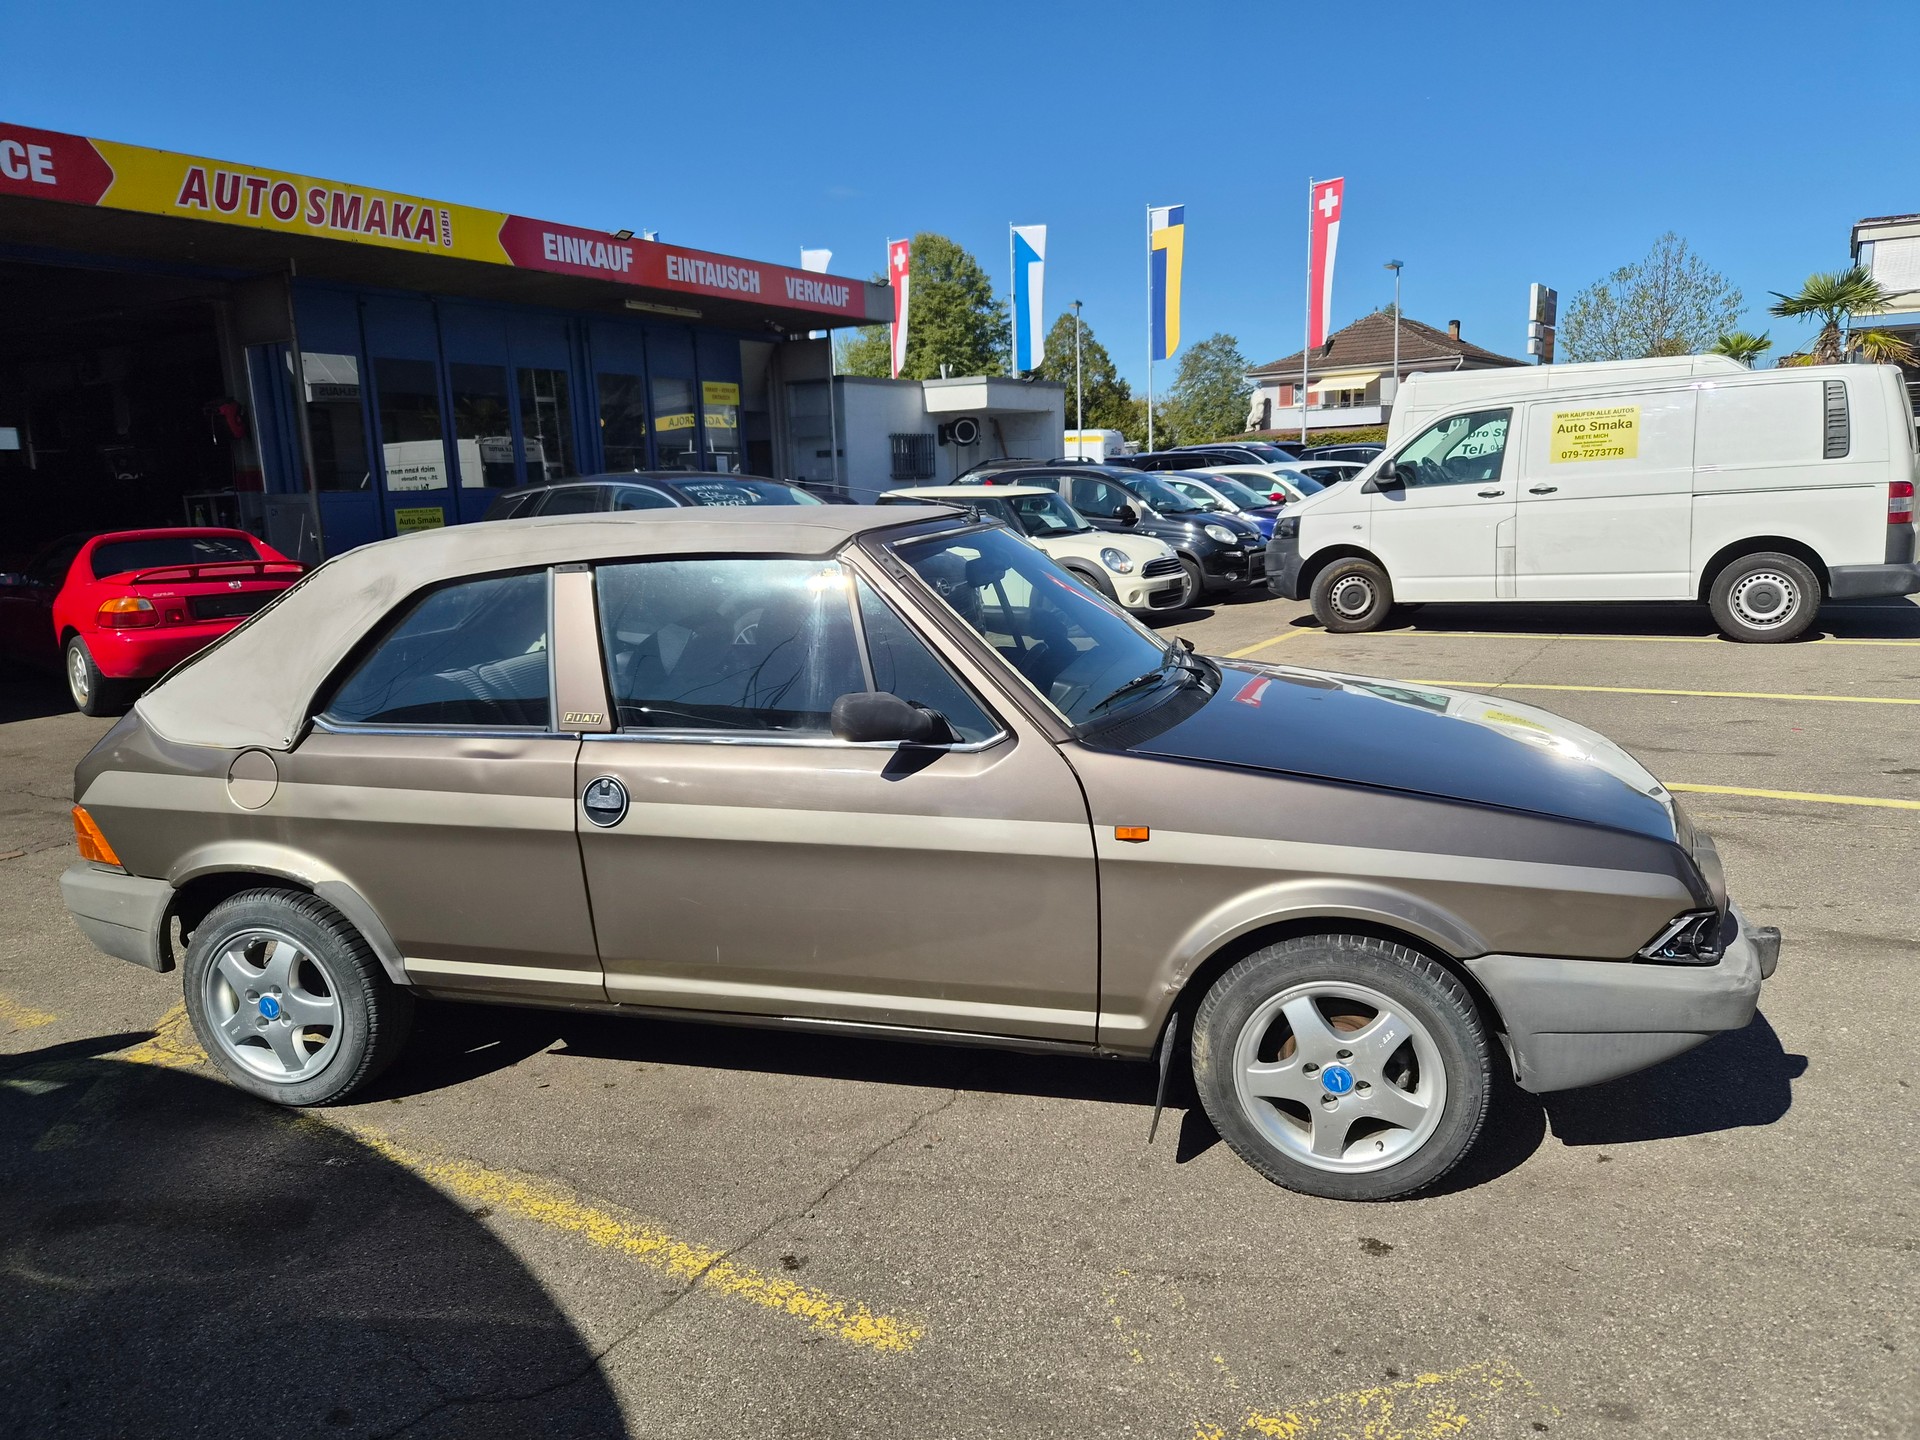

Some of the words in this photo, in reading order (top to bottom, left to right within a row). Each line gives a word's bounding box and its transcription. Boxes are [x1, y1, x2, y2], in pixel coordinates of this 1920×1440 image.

[0, 139, 57, 184] CE
[177, 166, 299, 220] AUTO
[305, 188, 436, 243] SMAKA
[440, 210, 451, 247] GMBH
[542, 231, 633, 273] EINKAUF
[666, 255, 760, 294] EINTAUSCH
[785, 276, 850, 307] VERKAUF
[1557, 423, 1586, 434] Auto
[1589, 419, 1633, 431] Smaka
[1462, 443, 1487, 455] Tel.
[1561, 447, 1624, 459] 079-7273778
[399, 517, 416, 525] Auto
[417, 515, 441, 525] Smaka
[565, 713, 601, 723] FIAT
